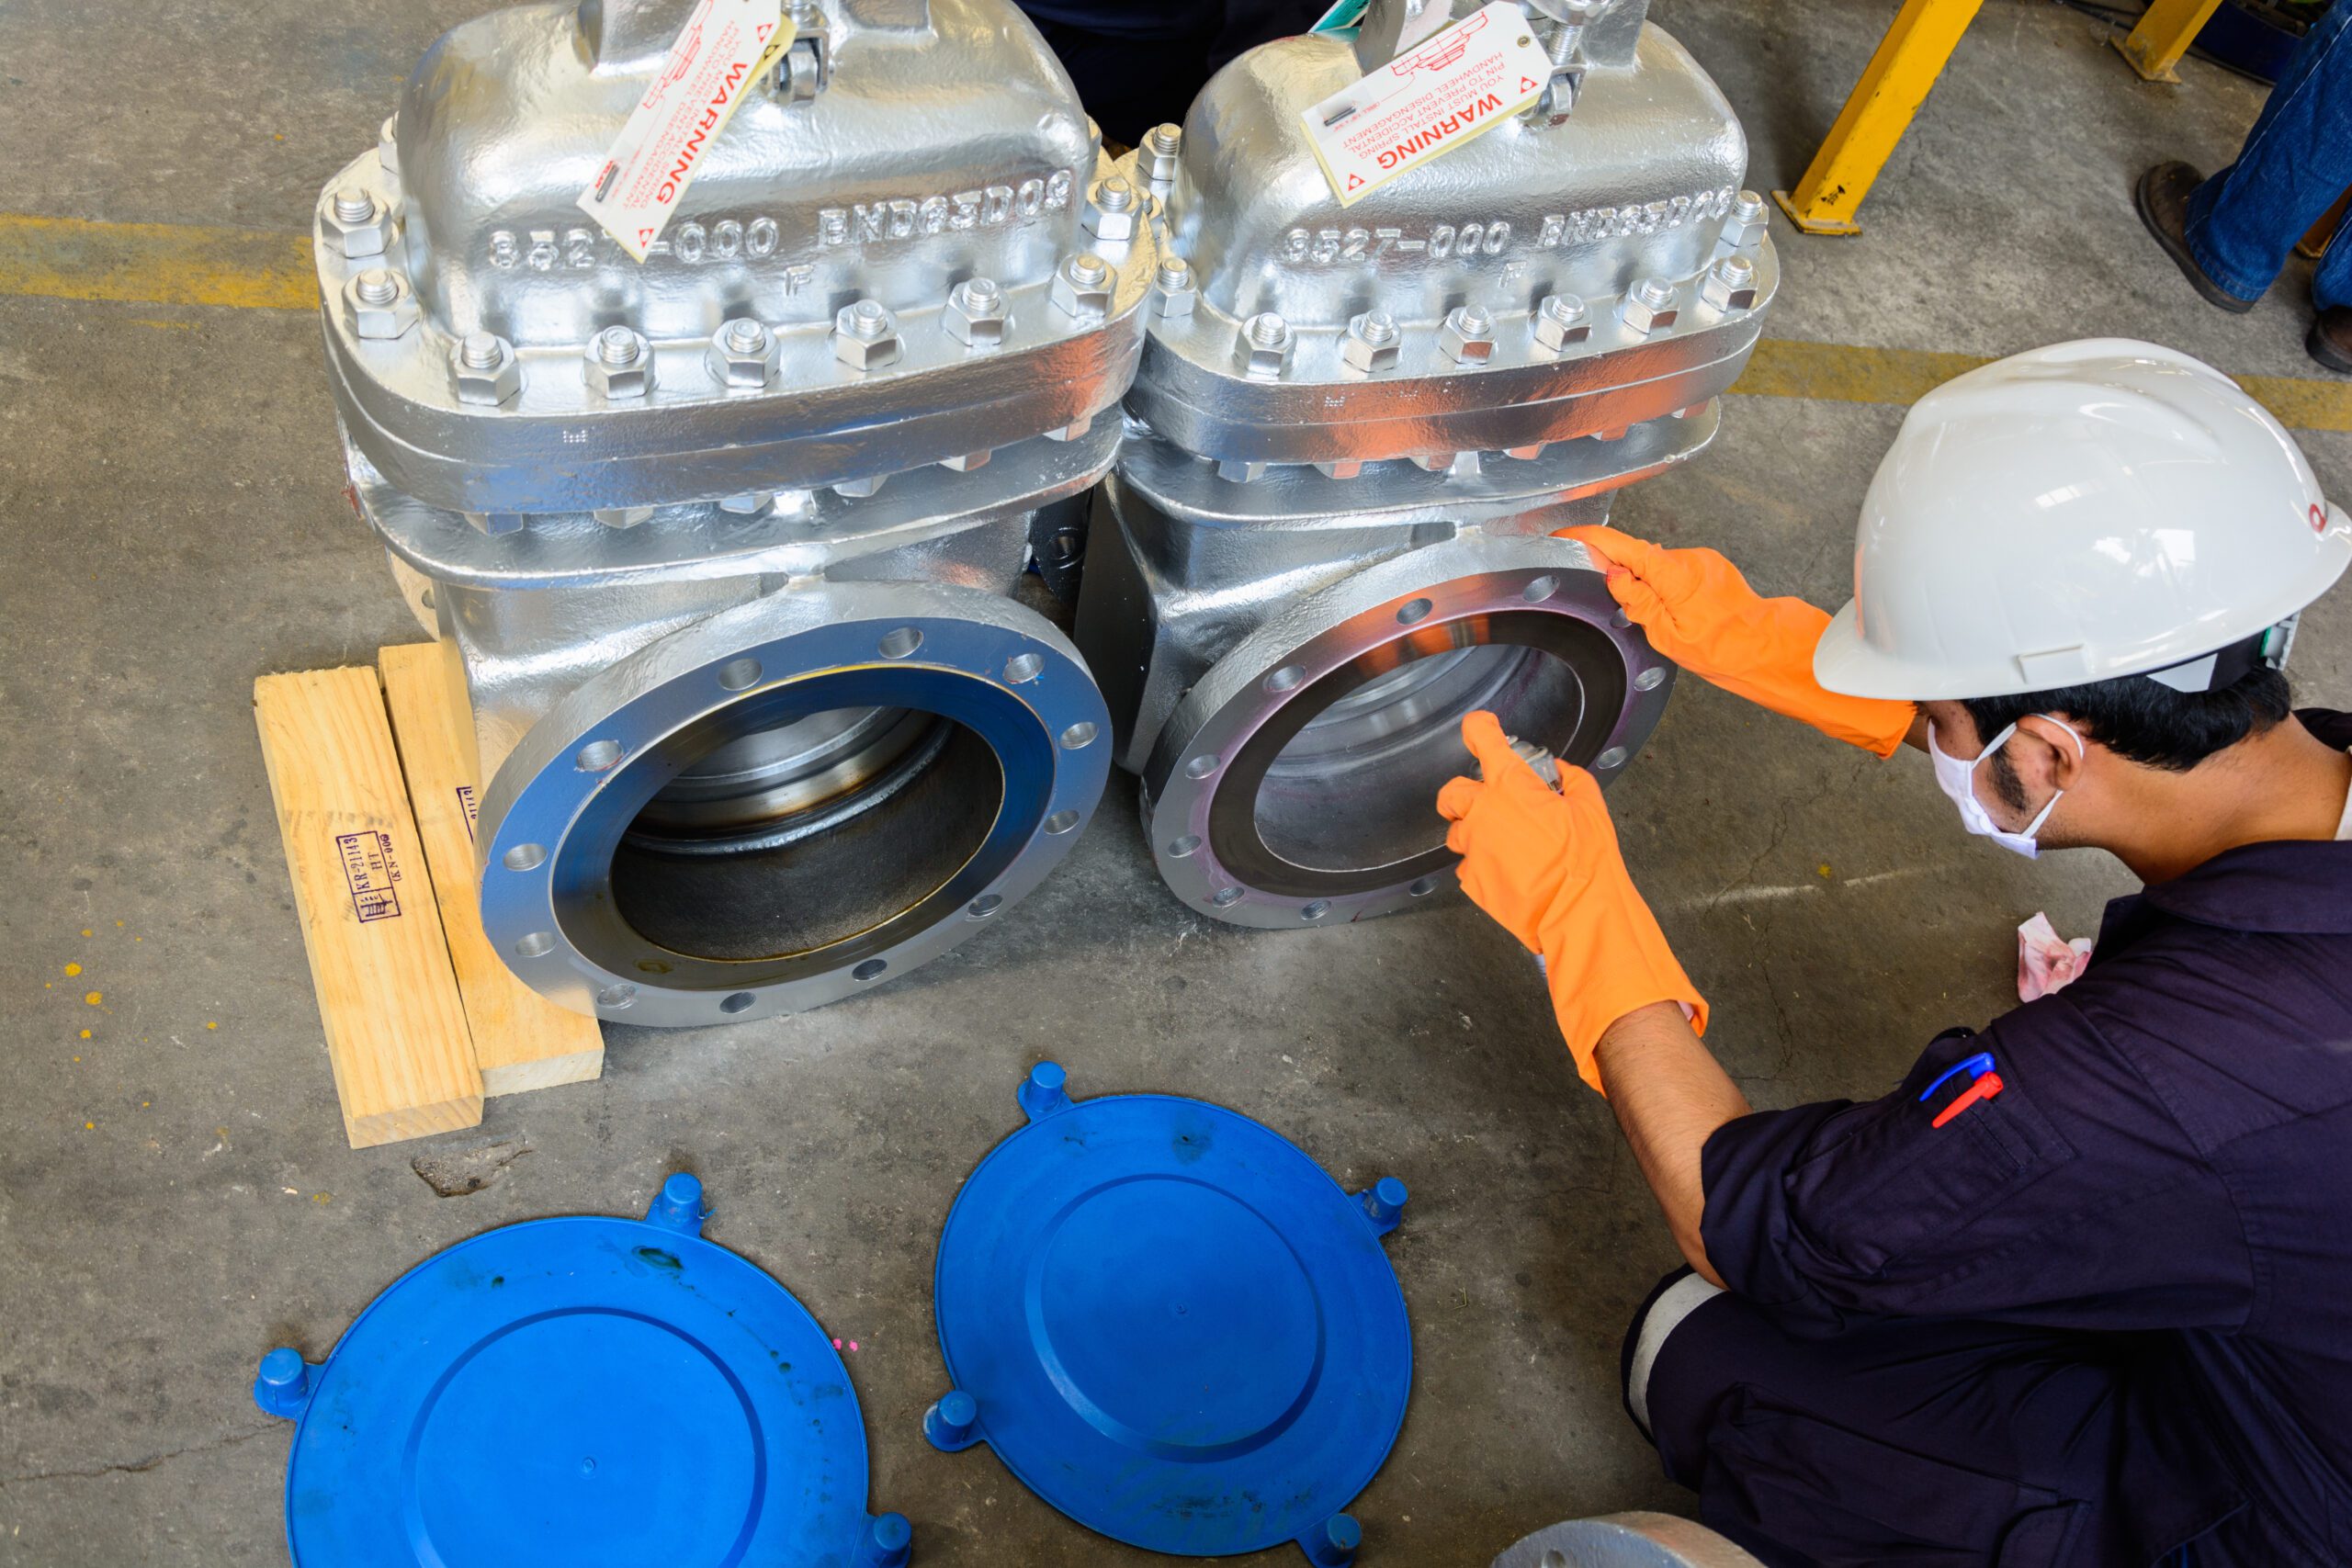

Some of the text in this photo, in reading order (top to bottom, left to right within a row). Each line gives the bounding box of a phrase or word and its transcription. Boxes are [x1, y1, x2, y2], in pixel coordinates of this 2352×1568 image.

[655, 59, 747, 206] WARNING
[1340, 51, 1503, 148] HANDWHEEL DISENGAGEMENT
[1347, 62, 1505, 154] PIN TO PREVENT ACCIDENTAL
[1357, 73, 1503, 160] YOU MUST INSTALL SPRING
[1375, 90, 1503, 171] WARNING
[489, 217, 780, 271] 852-000
[343, 837, 370, 891] KR-21143
[368, 852, 383, 872] HT
